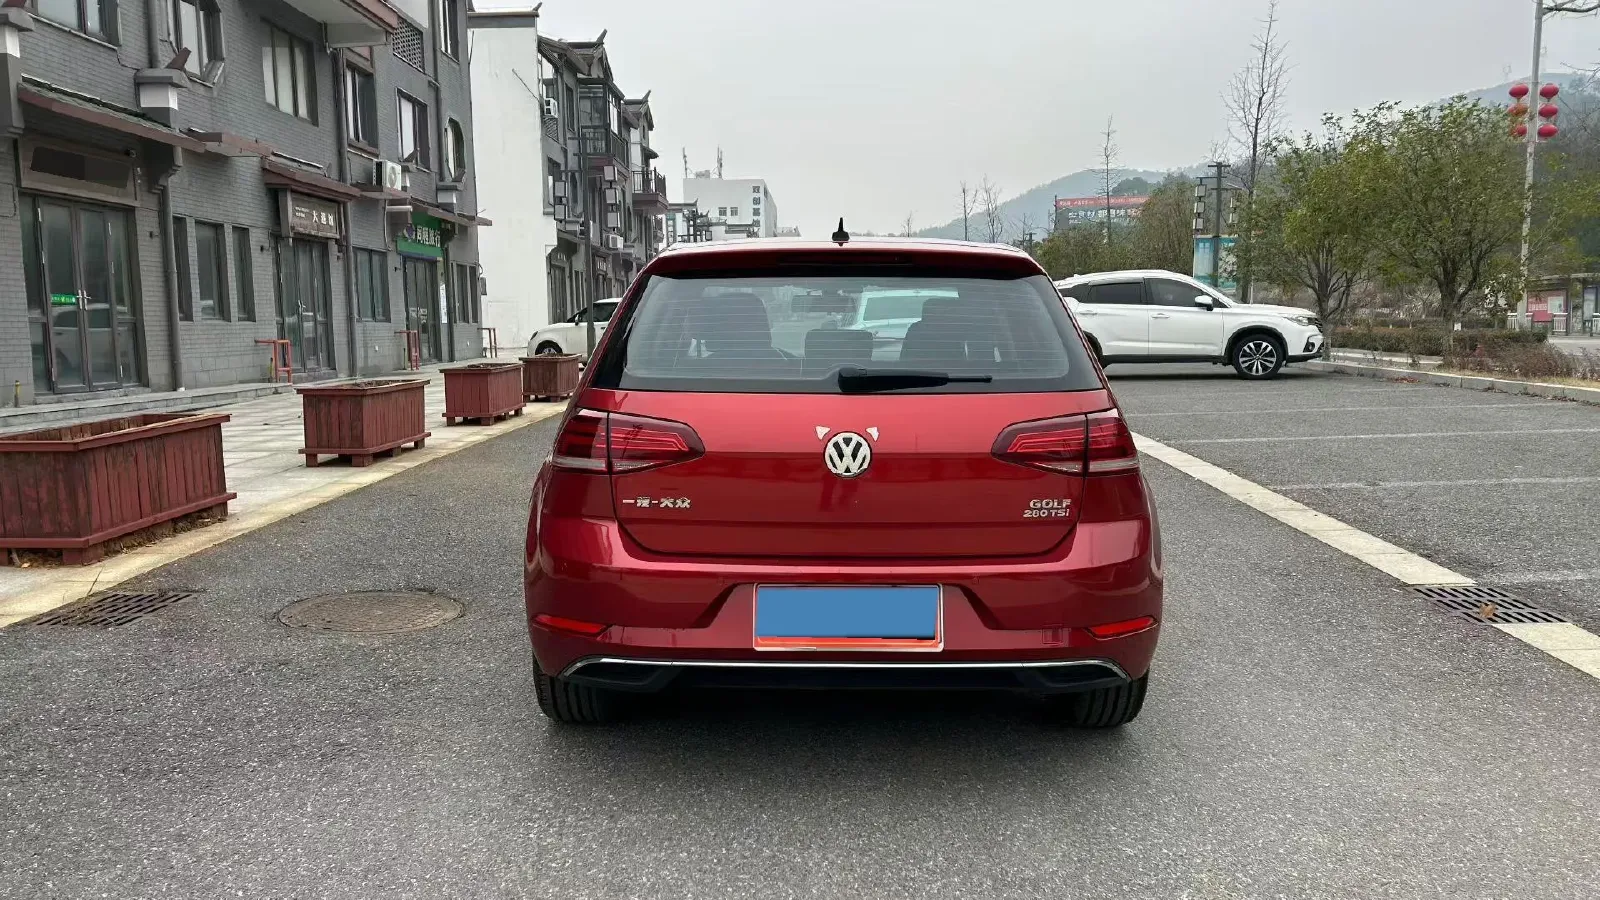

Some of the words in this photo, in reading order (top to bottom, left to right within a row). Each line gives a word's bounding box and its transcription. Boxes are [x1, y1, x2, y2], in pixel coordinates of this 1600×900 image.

[825, 432, 871, 476] VW
[1029, 498, 1071, 508] GOLF
[1023, 509, 1048, 517] 280
